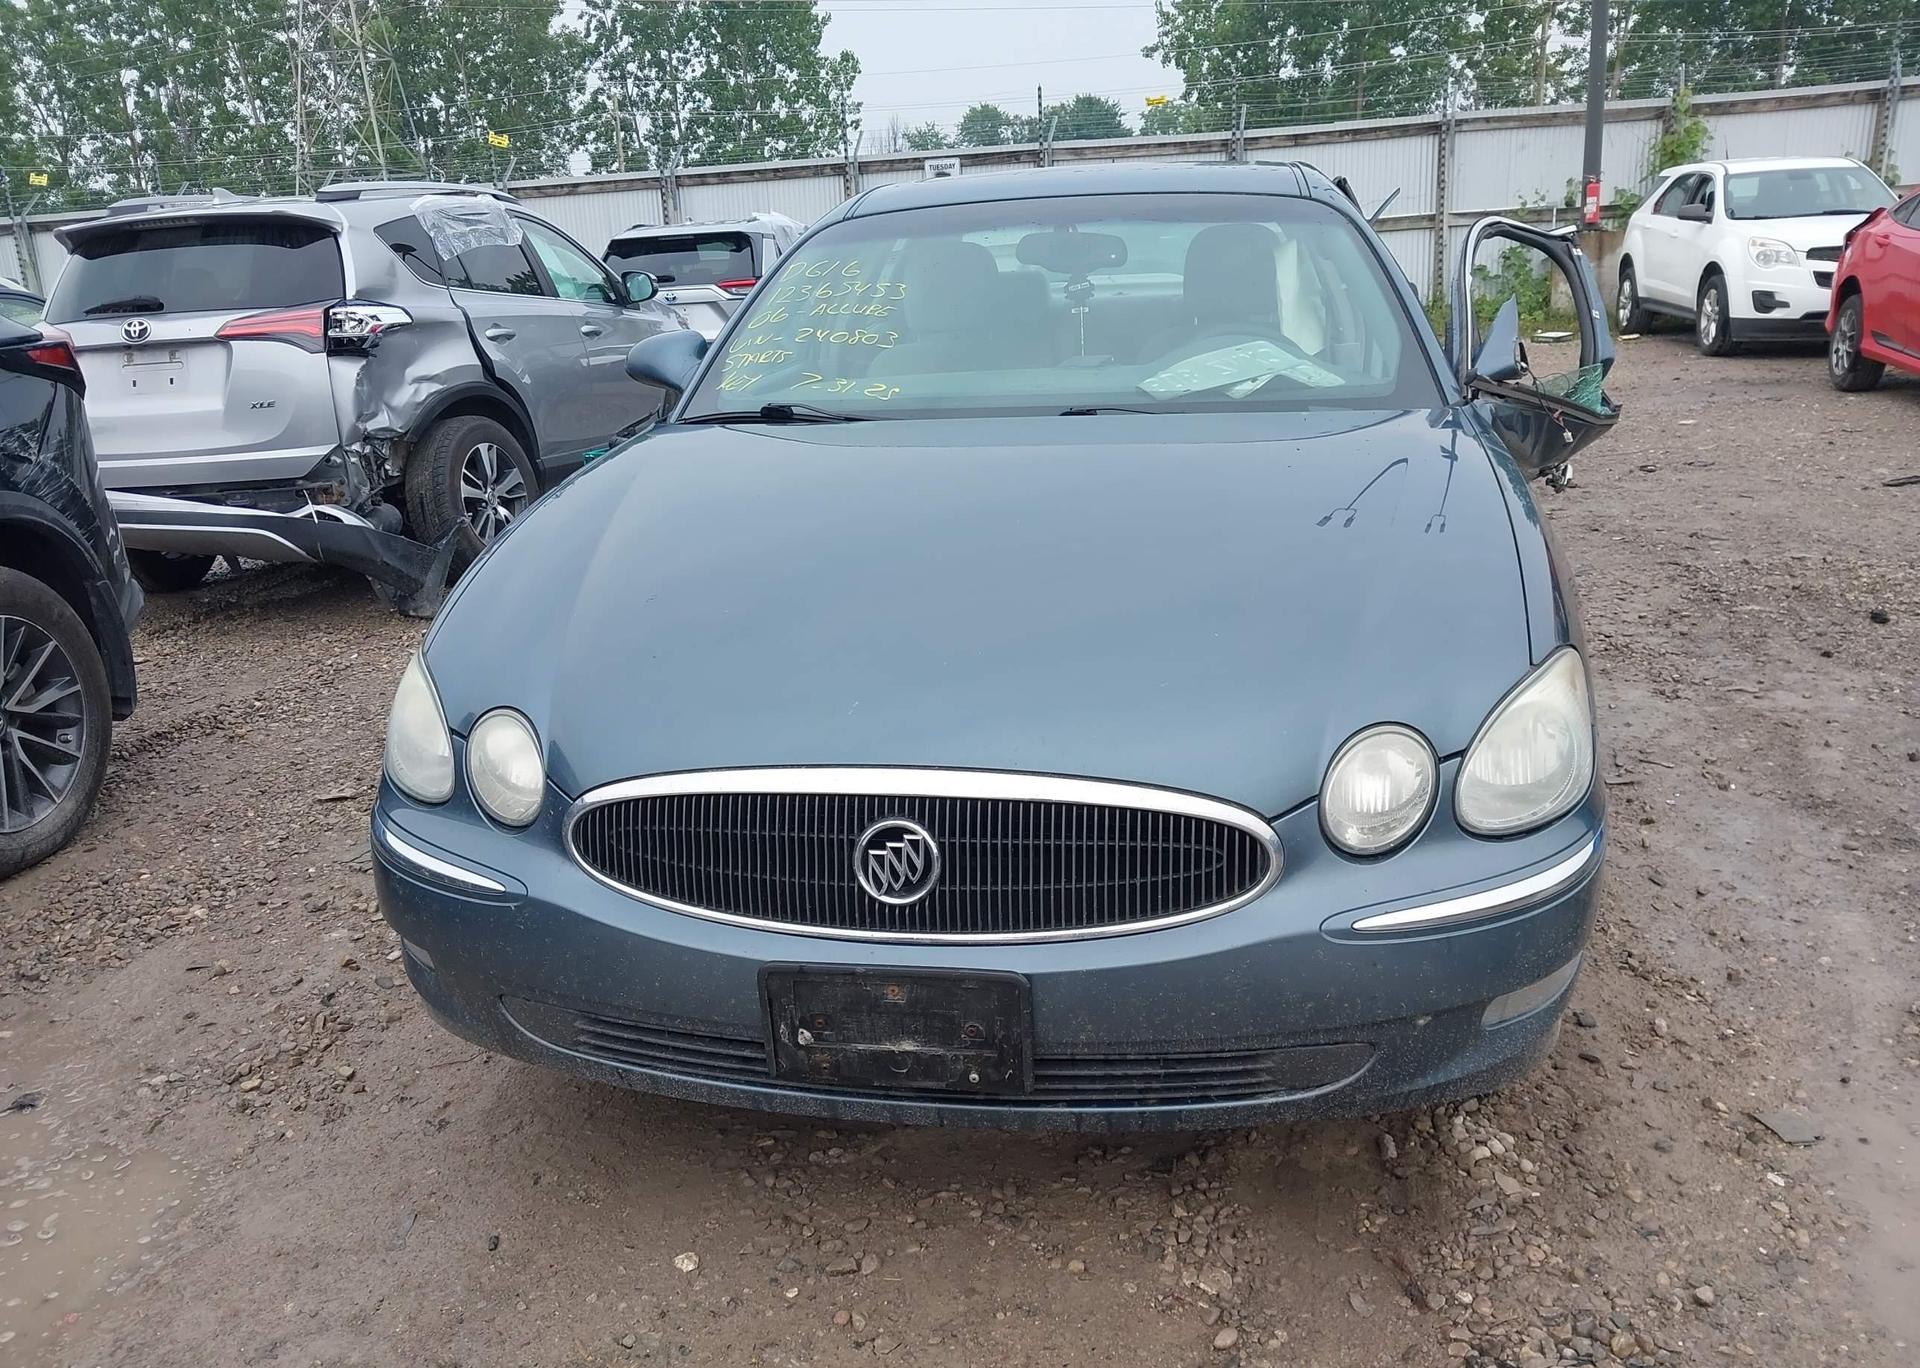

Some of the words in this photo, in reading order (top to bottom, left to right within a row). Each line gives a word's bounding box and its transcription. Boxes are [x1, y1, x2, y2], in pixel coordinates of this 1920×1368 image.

[929, 162, 956, 171] TUESDAY
[795, 328, 899, 348] 240803
[250, 401, 276, 410] XLE
